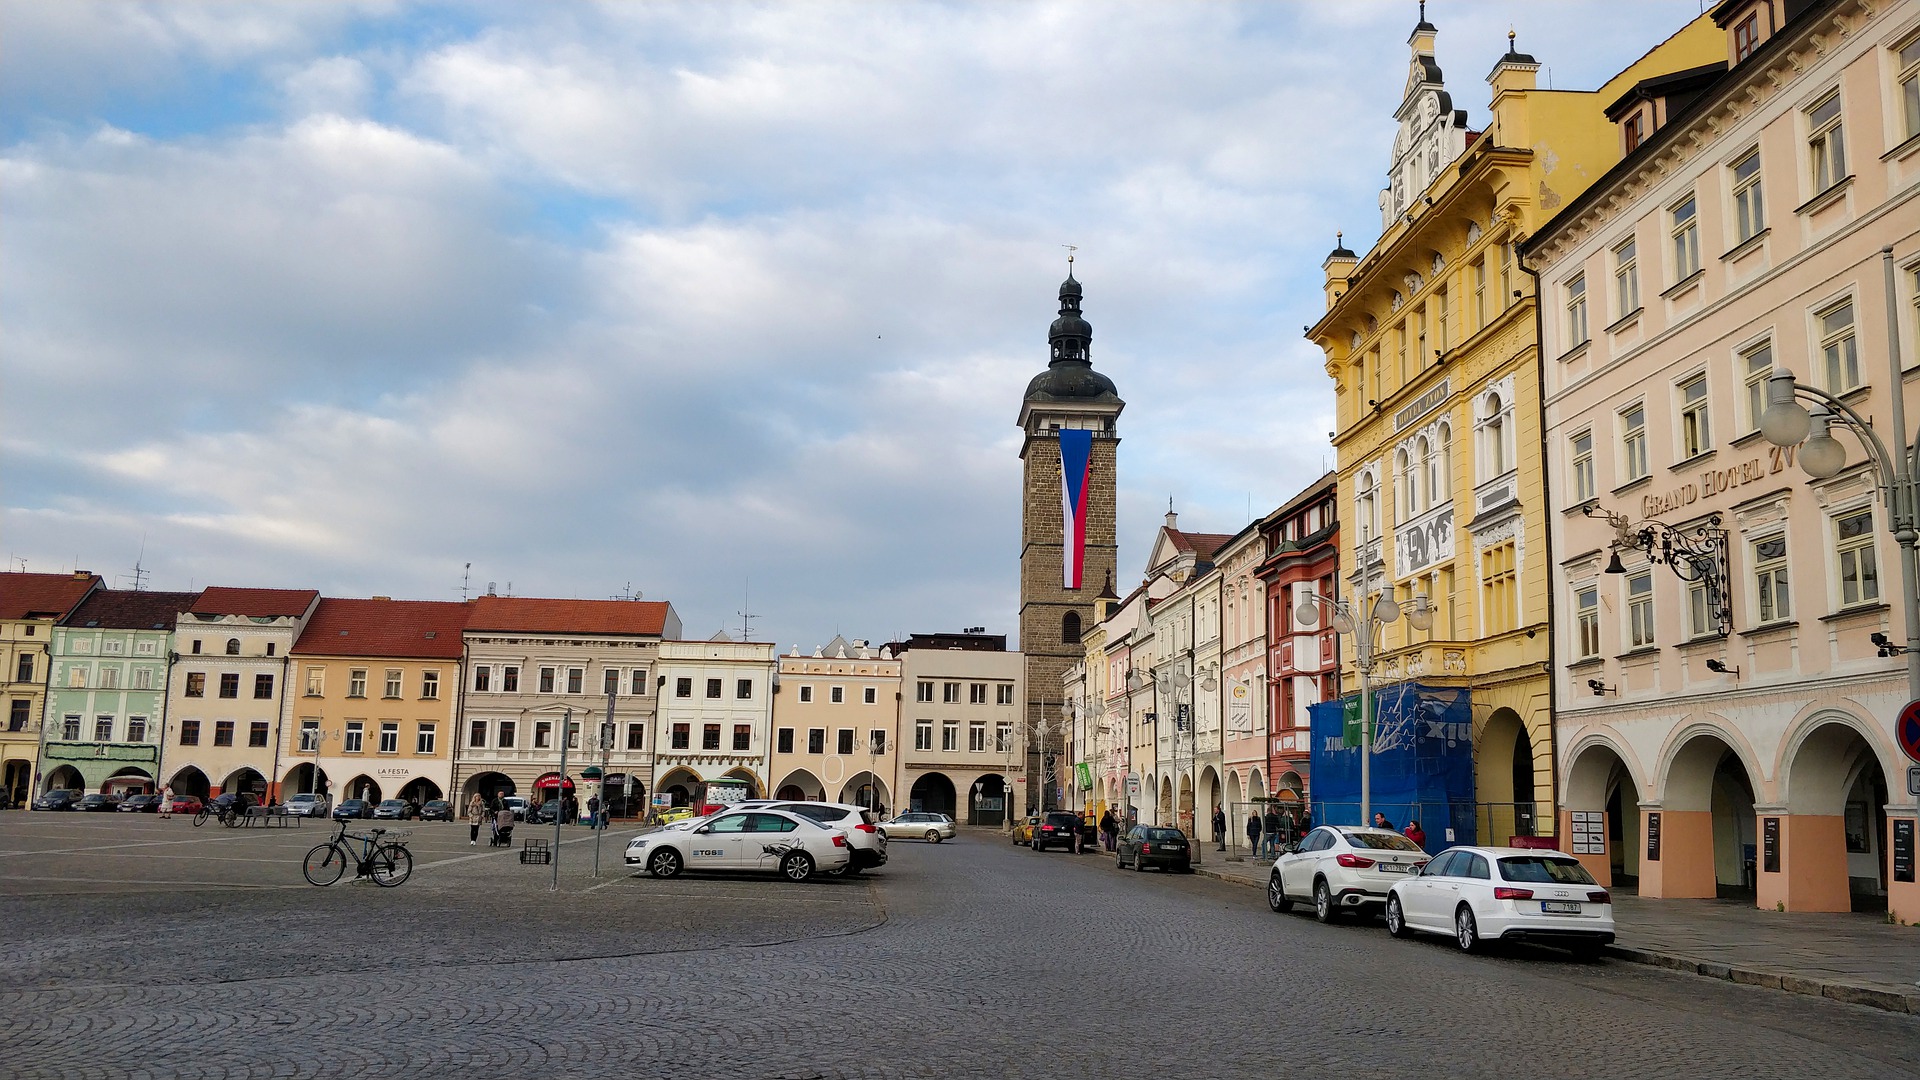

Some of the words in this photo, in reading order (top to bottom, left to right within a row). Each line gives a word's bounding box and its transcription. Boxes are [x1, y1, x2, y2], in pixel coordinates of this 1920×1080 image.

[1640, 483, 1698, 519] GRAND
[1700, 458, 1765, 499] HOTEL
[1768, 441, 1804, 475] ZV
